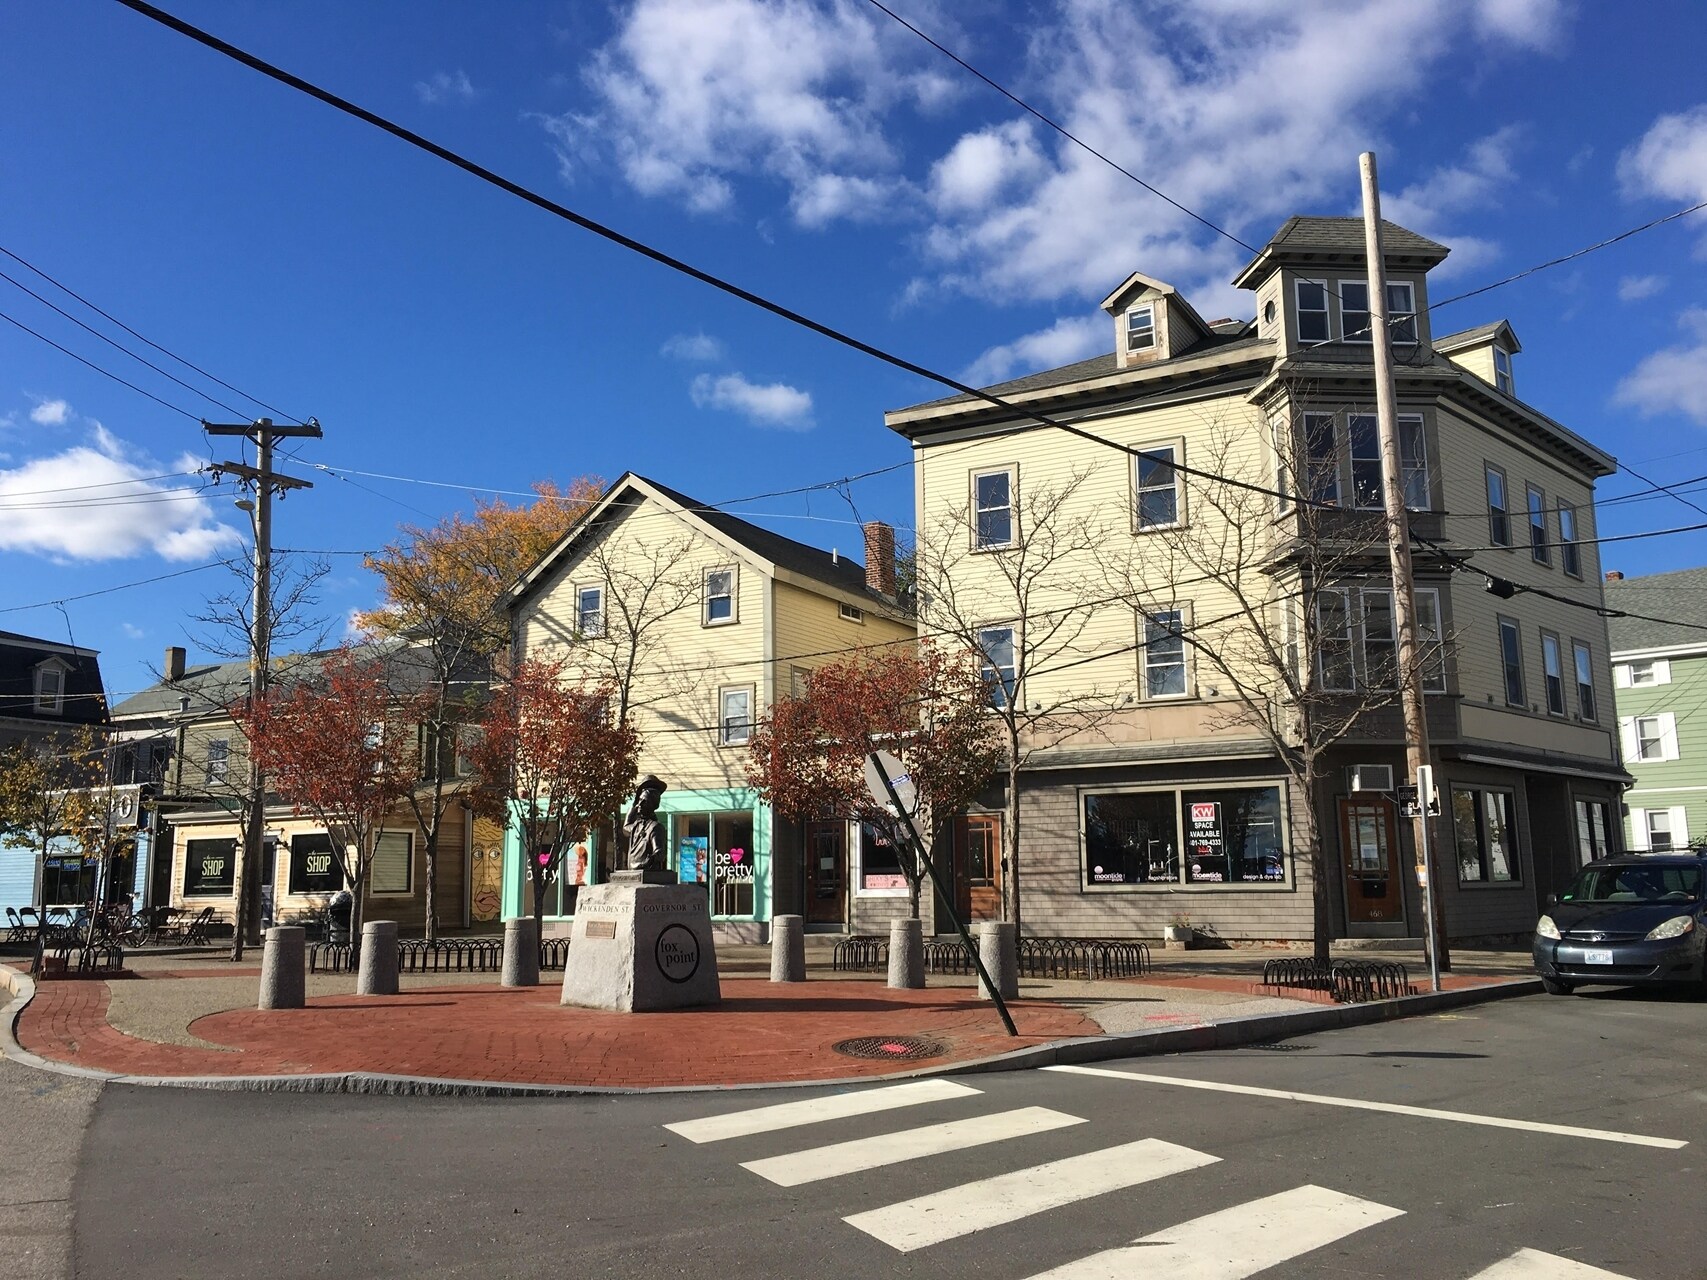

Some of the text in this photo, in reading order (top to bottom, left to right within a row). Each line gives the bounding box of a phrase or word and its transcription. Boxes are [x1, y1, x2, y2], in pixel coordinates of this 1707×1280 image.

[1193, 807, 1213, 818] KW
[1194, 821, 1214, 829] SPACE
[1189, 830, 1221, 838] AVAILABLE
[306, 855, 331, 873] SHOP
[715, 849, 731, 864] be
[201, 859, 225, 876] SHOP
[715, 863, 753, 880] pretty
[582, 905, 619, 913] WICKENDEN
[643, 904, 687, 913] GOVERNOR
[660, 938, 678, 953] fox
[666, 951, 695, 967] point
